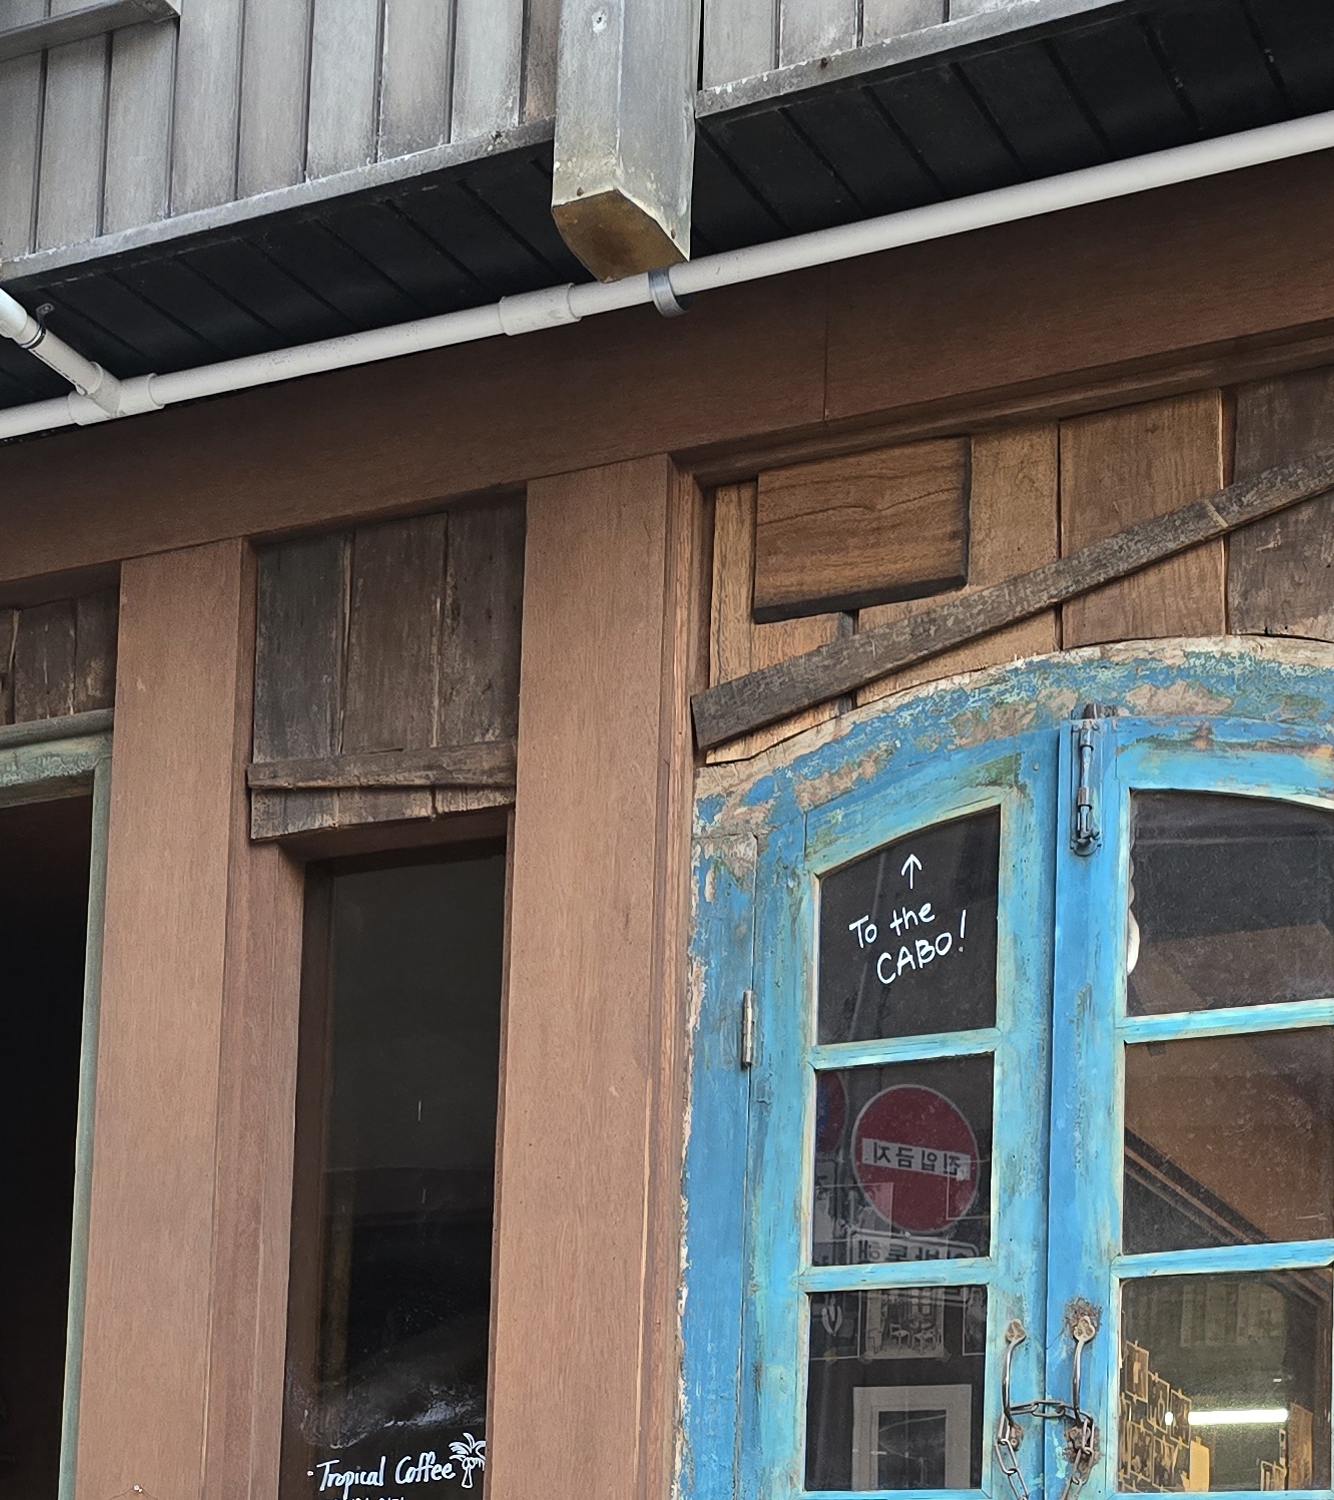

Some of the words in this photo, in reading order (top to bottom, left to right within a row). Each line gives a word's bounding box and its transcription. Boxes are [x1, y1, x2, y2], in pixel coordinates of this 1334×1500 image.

[849, 915, 877, 948] To
[890, 903, 935, 936] the
[316, 1456, 385, 1500] Tropical
[395, 1451, 456, 1484] Coffee
